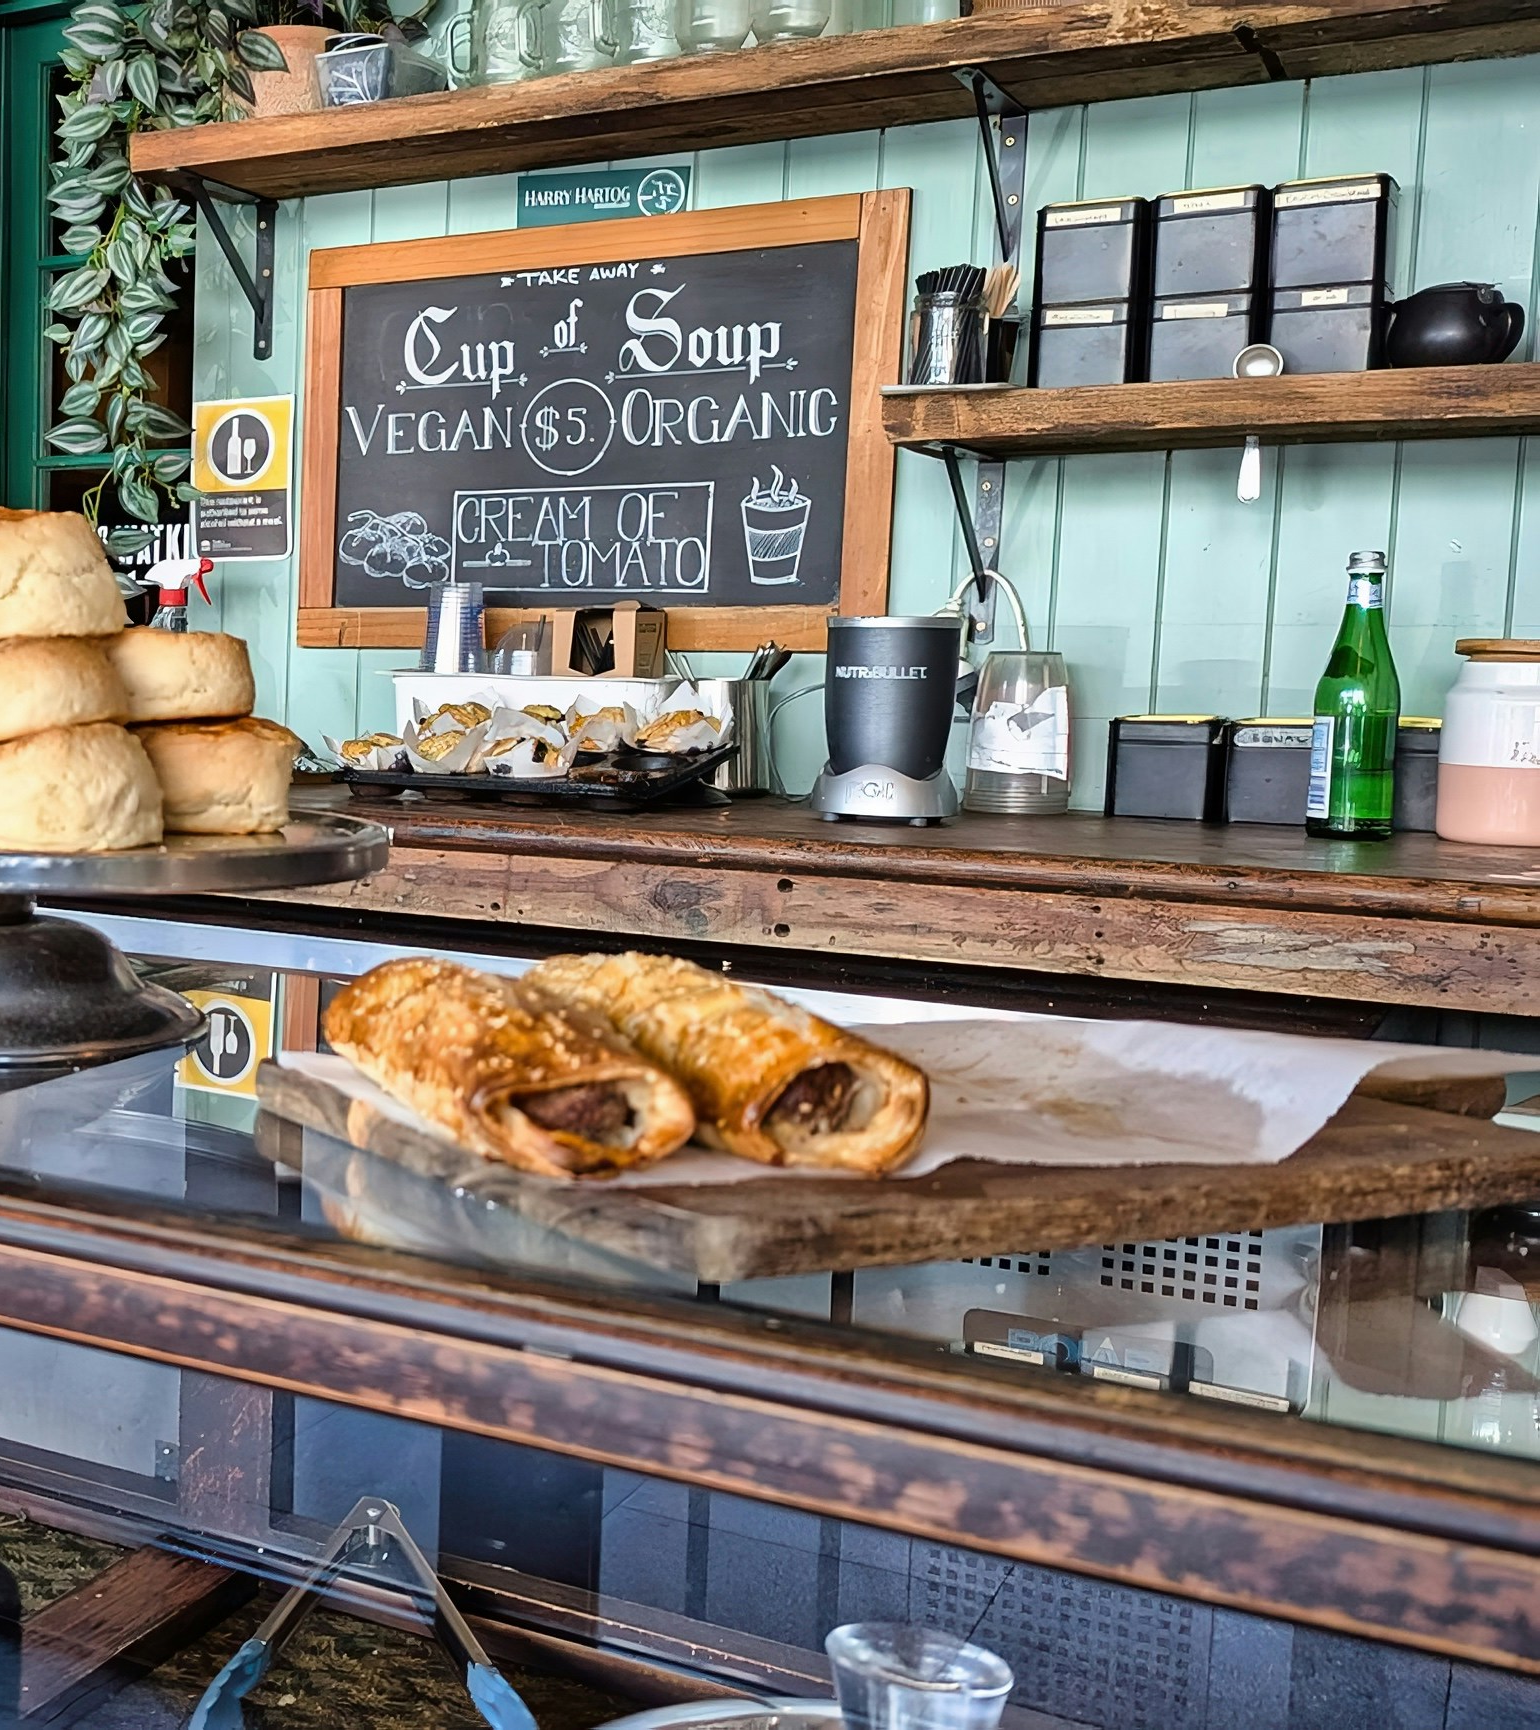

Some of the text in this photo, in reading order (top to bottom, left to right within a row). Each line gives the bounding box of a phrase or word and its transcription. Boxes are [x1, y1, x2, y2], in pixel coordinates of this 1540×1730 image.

[524, 186, 631, 207] HARRY HARTOG
[516, 262, 640, 287] TAKE AWAY
[403, 283, 783, 400] Cup of Soup
[345, 403, 513, 457] VEGAN
[620, 388, 839, 448] ORGANIC
[457, 492, 679, 546] CREAM OF
[532, 536, 706, 588] TOMATO
